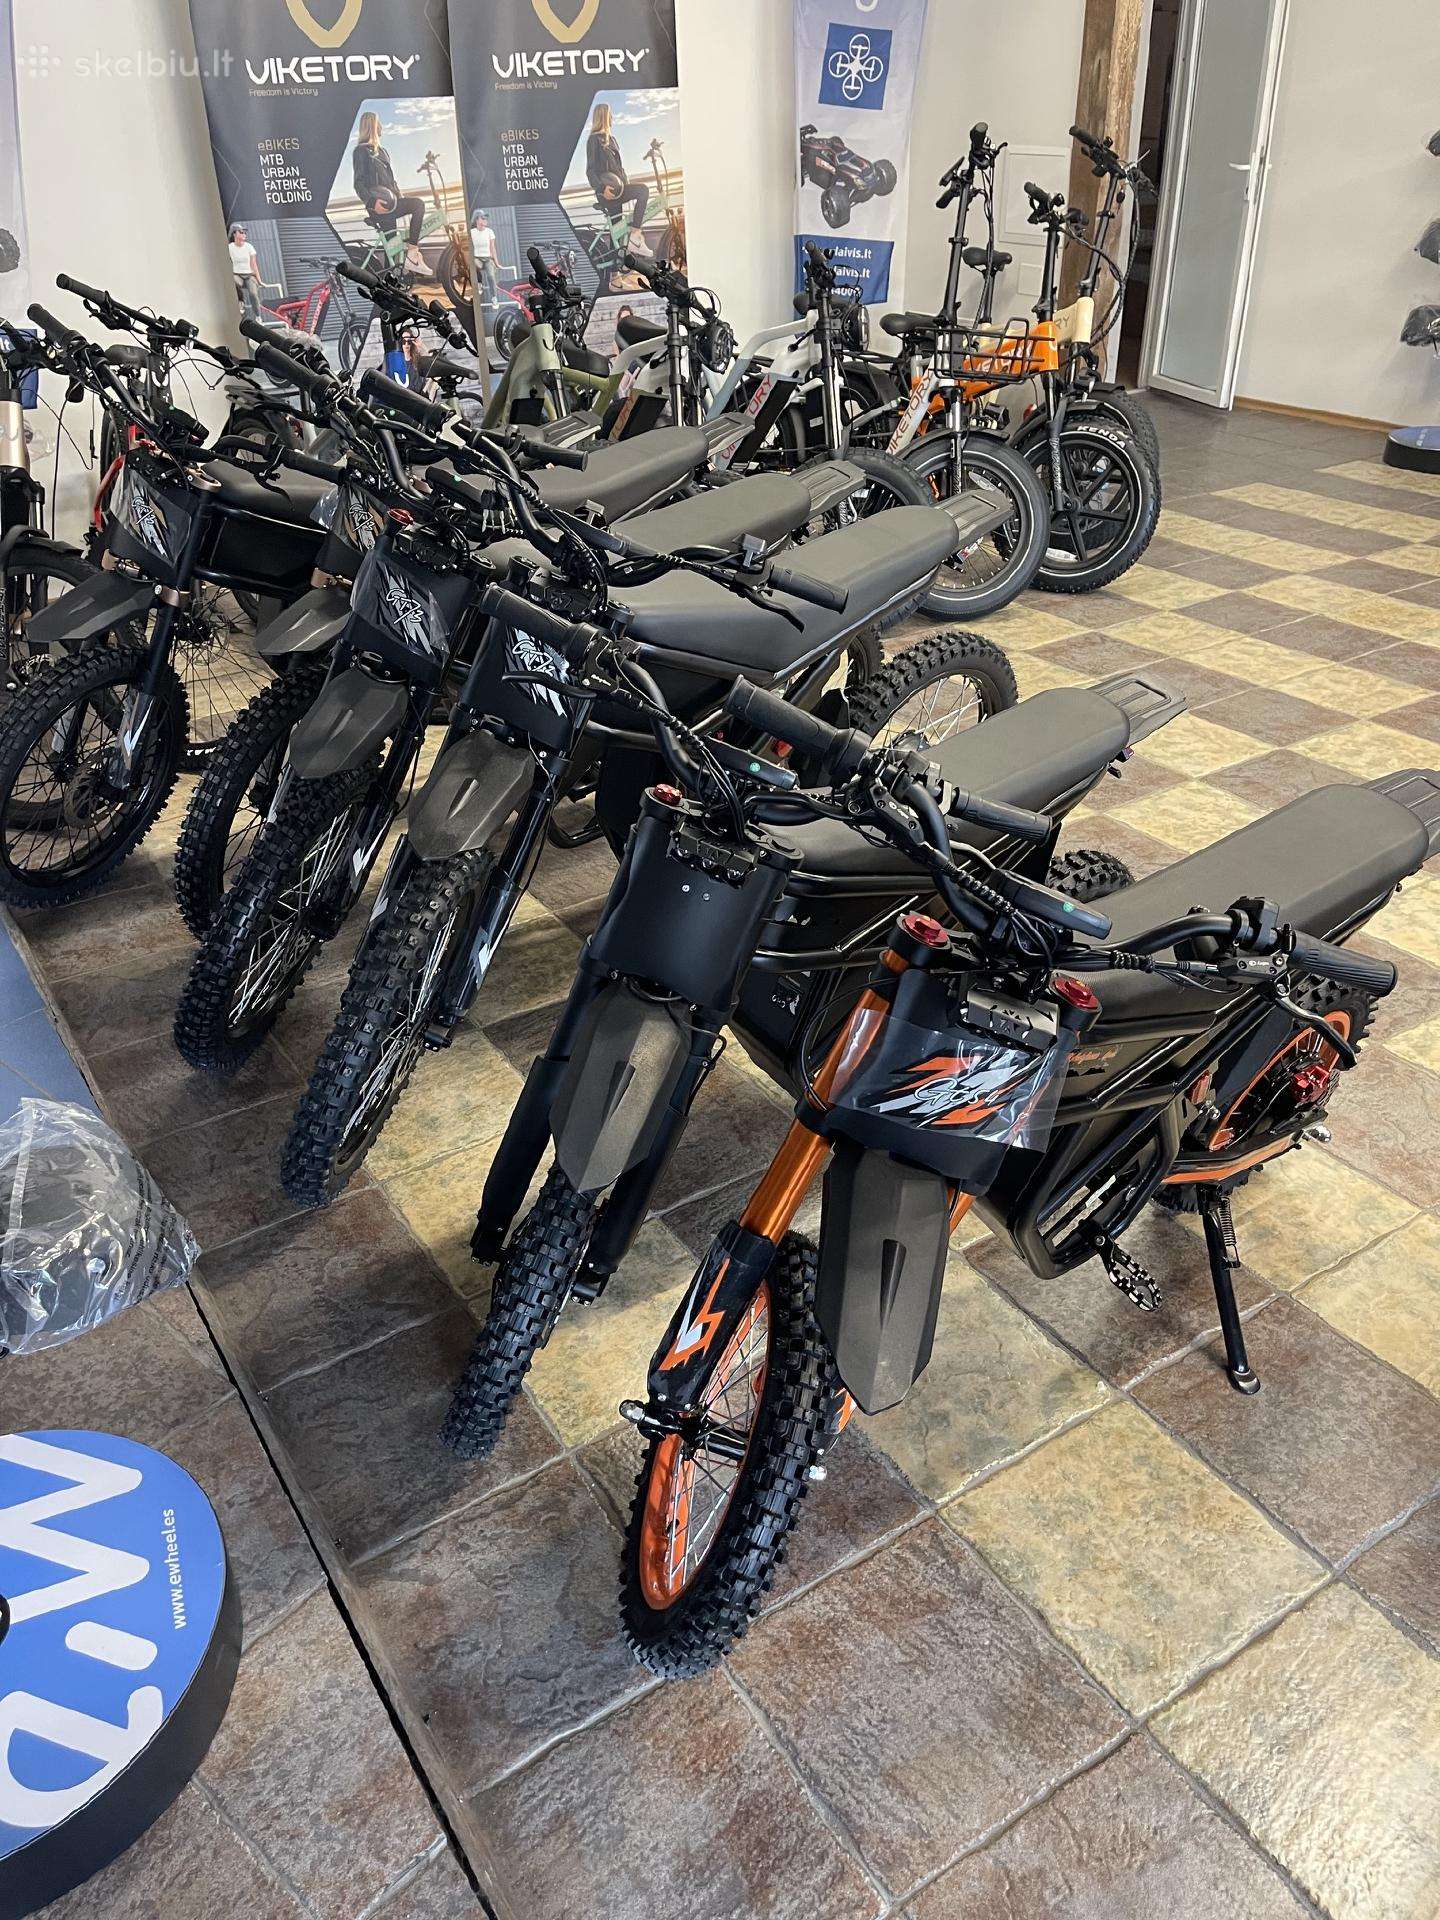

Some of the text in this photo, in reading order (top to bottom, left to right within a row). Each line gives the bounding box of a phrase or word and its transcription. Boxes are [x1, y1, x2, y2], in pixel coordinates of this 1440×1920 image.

[494, 82, 526, 91] Freedom
[533, 80, 557, 89] Victory
[248, 88, 282, 97] Freedom
[291, 87, 318, 96] Victory
[500, 129, 540, 142] eBIKES
[257, 138, 300, 151] eBIKES
[502, 145, 525, 155] MTB
[259, 154, 284, 166] MTB
[503, 156, 538, 167] URBAN
[261, 166, 300, 178] URBAN
[505, 167, 544, 179] FATBIKE
[264, 178, 307, 191] FATBIKE
[507, 178, 549, 192] FOLDING
[266, 190, 312, 204] FOLDING
[1077, 425, 1126, 448] KENDA
[161, 1508, 187, 1630] www.ewheel.es
